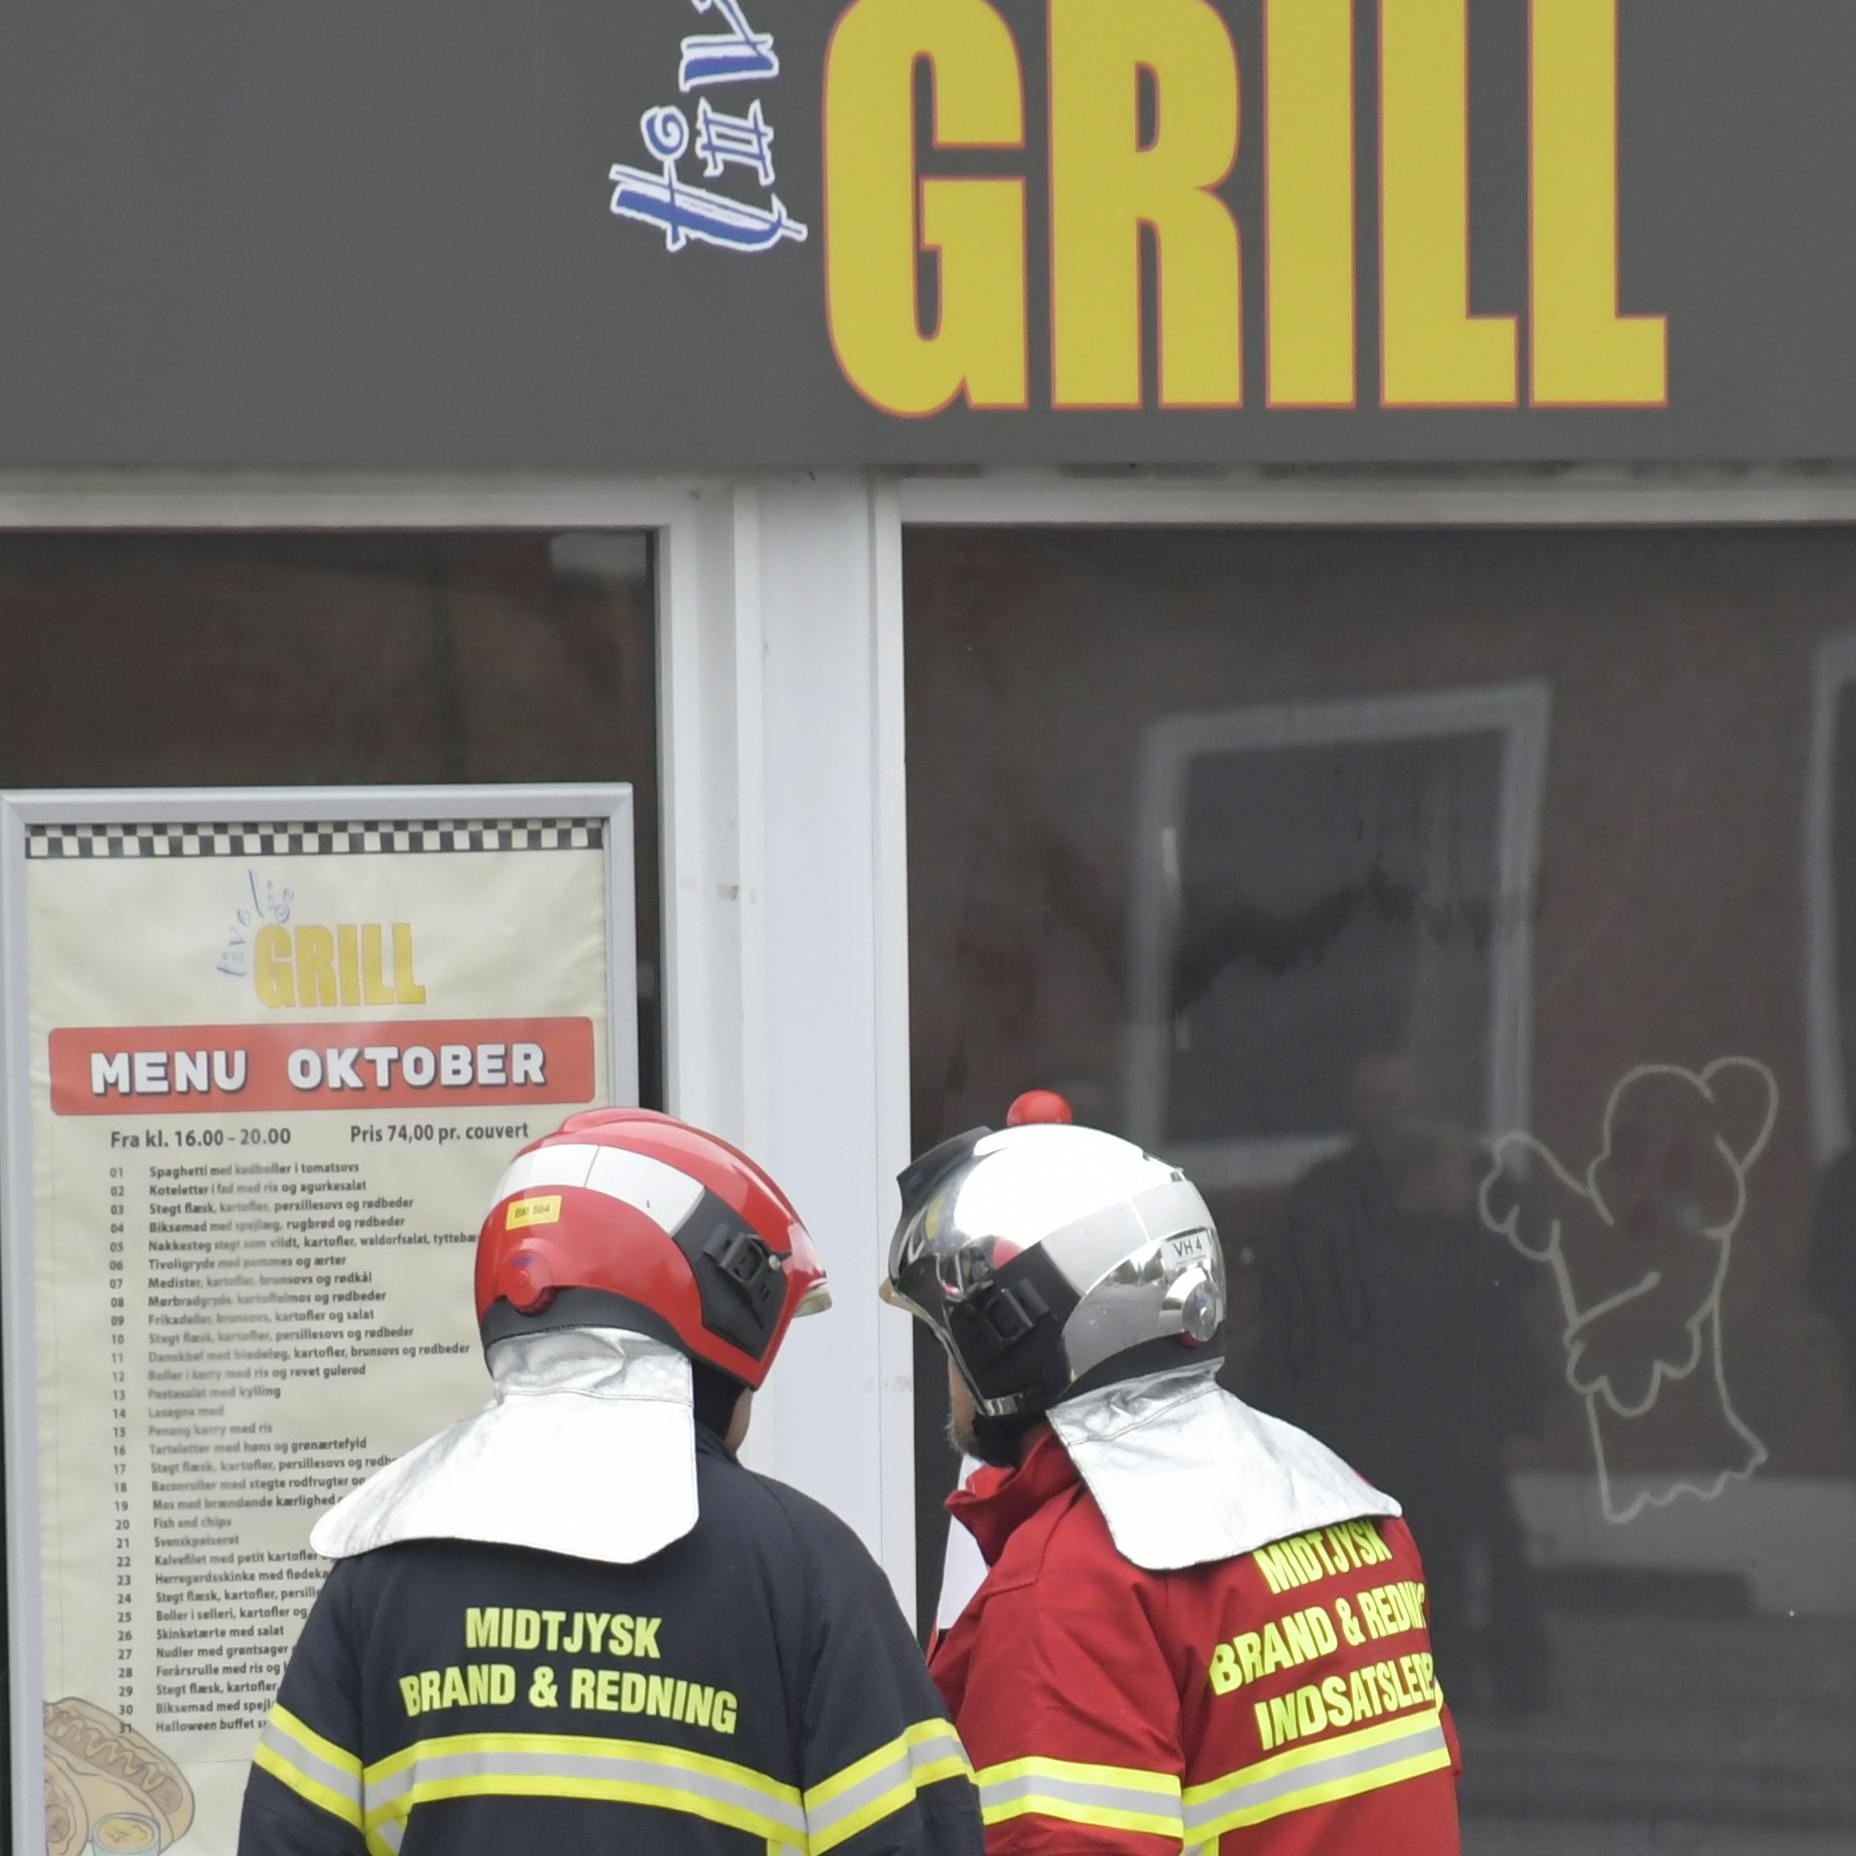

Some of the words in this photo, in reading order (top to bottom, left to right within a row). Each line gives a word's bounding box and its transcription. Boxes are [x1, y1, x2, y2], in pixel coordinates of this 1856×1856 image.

[822, 0, 1668, 420] GRILL
[253, 922, 428, 1008] GRILL
[89, 1049, 248, 1096] MENU
[286, 1042, 548, 1091] OKTOBER
[110, 1130, 140, 1148] Fra
[145, 1128, 169, 1147] kl.
[174, 1128, 224, 1147] 16.00
[240, 1127, 291, 1146] 20.00
[350, 1123, 383, 1143] Pris
[387, 1122, 434, 1143] 74,00
[437, 1127, 461, 1145] pr.
[465, 1123, 529, 1141] couvert
[108, 1165, 124, 1178] 01
[149, 1163, 207, 1180] Spaghetti
[300, 1161, 359, 1173] tomatsovs
[149, 1182, 208, 1196] Koteletter
[300, 1178, 366, 1195] agurkesalat
[149, 1201, 181, 1217] Stegt
[184, 1201, 217, 1215] flæsk,
[274, 1197, 343, 1214] persillesovs
[362, 1195, 412, 1209] rødbeder
[109, 1220, 124, 1233] 04
[149, 1219, 207, 1233] Biksemad
[286, 1216, 335, 1232] rugbrød
[354, 1214, 404, 1228] rødbeder
[148, 1237, 212, 1254] Nakkesteg
[303, 1234, 357, 1249] kartofler,
[360, 1232, 431, 1247] waldorfsalat,
[1173, 1238, 1194, 1257] VH
[1195, 1235, 1203, 1251] 4
[149, 1256, 214, 1272] Tivoligryde
[314, 1254, 345, 1266] ærter
[108, 1276, 123, 1289] 07
[148, 1275, 204, 1290] Medister,
[334, 1270, 372, 1284] rødkål
[332, 1288, 385, 1302] rødbeder
[274, 1308, 324, 1322] kartofler
[346, 1307, 374, 1320] salat
[275, 1326, 344, 1343] persillesovs
[364, 1324, 412, 1338] rødbeder
[293, 1344, 348, 1359] kartofler,
[350, 1343, 399, 1357] brunsovs
[418, 1341, 469, 1354] rødbeder
[112, 1368, 125, 1381] 12
[289, 1365, 320, 1377] revet
[322, 1362, 366, 1378] gulerod
[238, 1383, 281, 1399] kylling
[112, 1405, 126, 1418] 14
[113, 1442, 126, 1455] 16
[291, 1436, 366, 1453] grønærtefyld
[278, 1455, 345, 1472] persillesovs
[114, 1479, 128, 1492] 18
[249, 1477, 286, 1492] stegte
[288, 1474, 348, 1490] rodfrugter
[276, 1492, 334, 1509] kærlighed
[115, 1517, 130, 1530] 20
[153, 1515, 174, 1528] Fish
[201, 1514, 231, 1530] chips
[116, 1555, 131, 1568] 22
[237, 1551, 264, 1565] petit
[267, 1548, 318, 1562] kartofler
[1252, 1518, 1393, 1595] MIDTJYSK
[258, 1568, 283, 1581] med
[117, 1591, 132, 1603] 24
[156, 1589, 183, 1605] Stegt
[186, 1588, 220, 1603] flæsk,
[224, 1586, 278, 1601] kartofler,
[156, 1608, 187, 1621] Boller
[197, 1606, 236, 1621] selleri,
[239, 1604, 289, 1618] kartofler
[117, 1628, 132, 1641] 26
[156, 1625, 226, 1639] Skinketærte
[229, 1624, 254, 1637] med
[257, 1623, 284, 1636] salat
[465, 1606, 662, 1659] MIDTJYSK
[156, 1645, 193, 1658] Nudler
[197, 1643, 223, 1657] med
[226, 1643, 287, 1658] grøntsager
[1209, 1605, 1338, 1696] BRAND
[1335, 1597, 1367, 1647] &
[118, 1665, 133, 1678] 28
[156, 1662, 219, 1676] Forårsrulle
[222, 1661, 246, 1674] med
[249, 1662, 263, 1673] ris
[156, 1682, 186, 1697] Stegt
[189, 1680, 223, 1695] flæsk,
[118, 1701, 133, 1714] 30
[155, 1699, 213, 1714] Biksemad
[216, 1698, 240, 1712] med
[399, 1663, 516, 1718] BRAND
[528, 1665, 559, 1708] &
[570, 1667, 738, 1736] REDNING
[155, 1718, 216, 1732] Halloween
[219, 1716, 254, 1729] buffet
